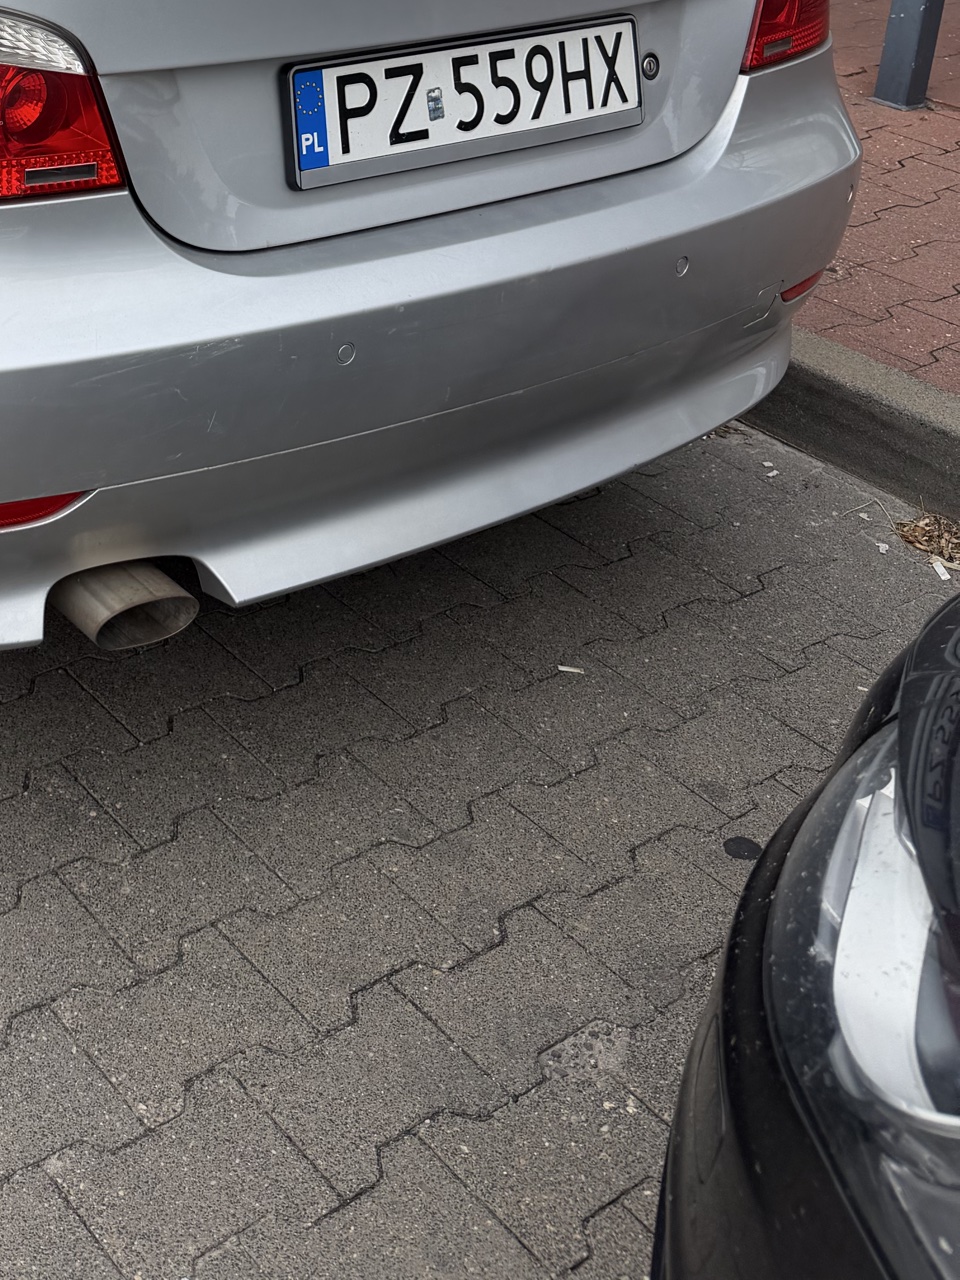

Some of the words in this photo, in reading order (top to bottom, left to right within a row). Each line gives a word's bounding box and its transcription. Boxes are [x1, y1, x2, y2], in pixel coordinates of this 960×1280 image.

[335, 62, 430, 155] PZ
[451, 31, 629, 132] 559HX
[301, 131, 324, 155] PL
